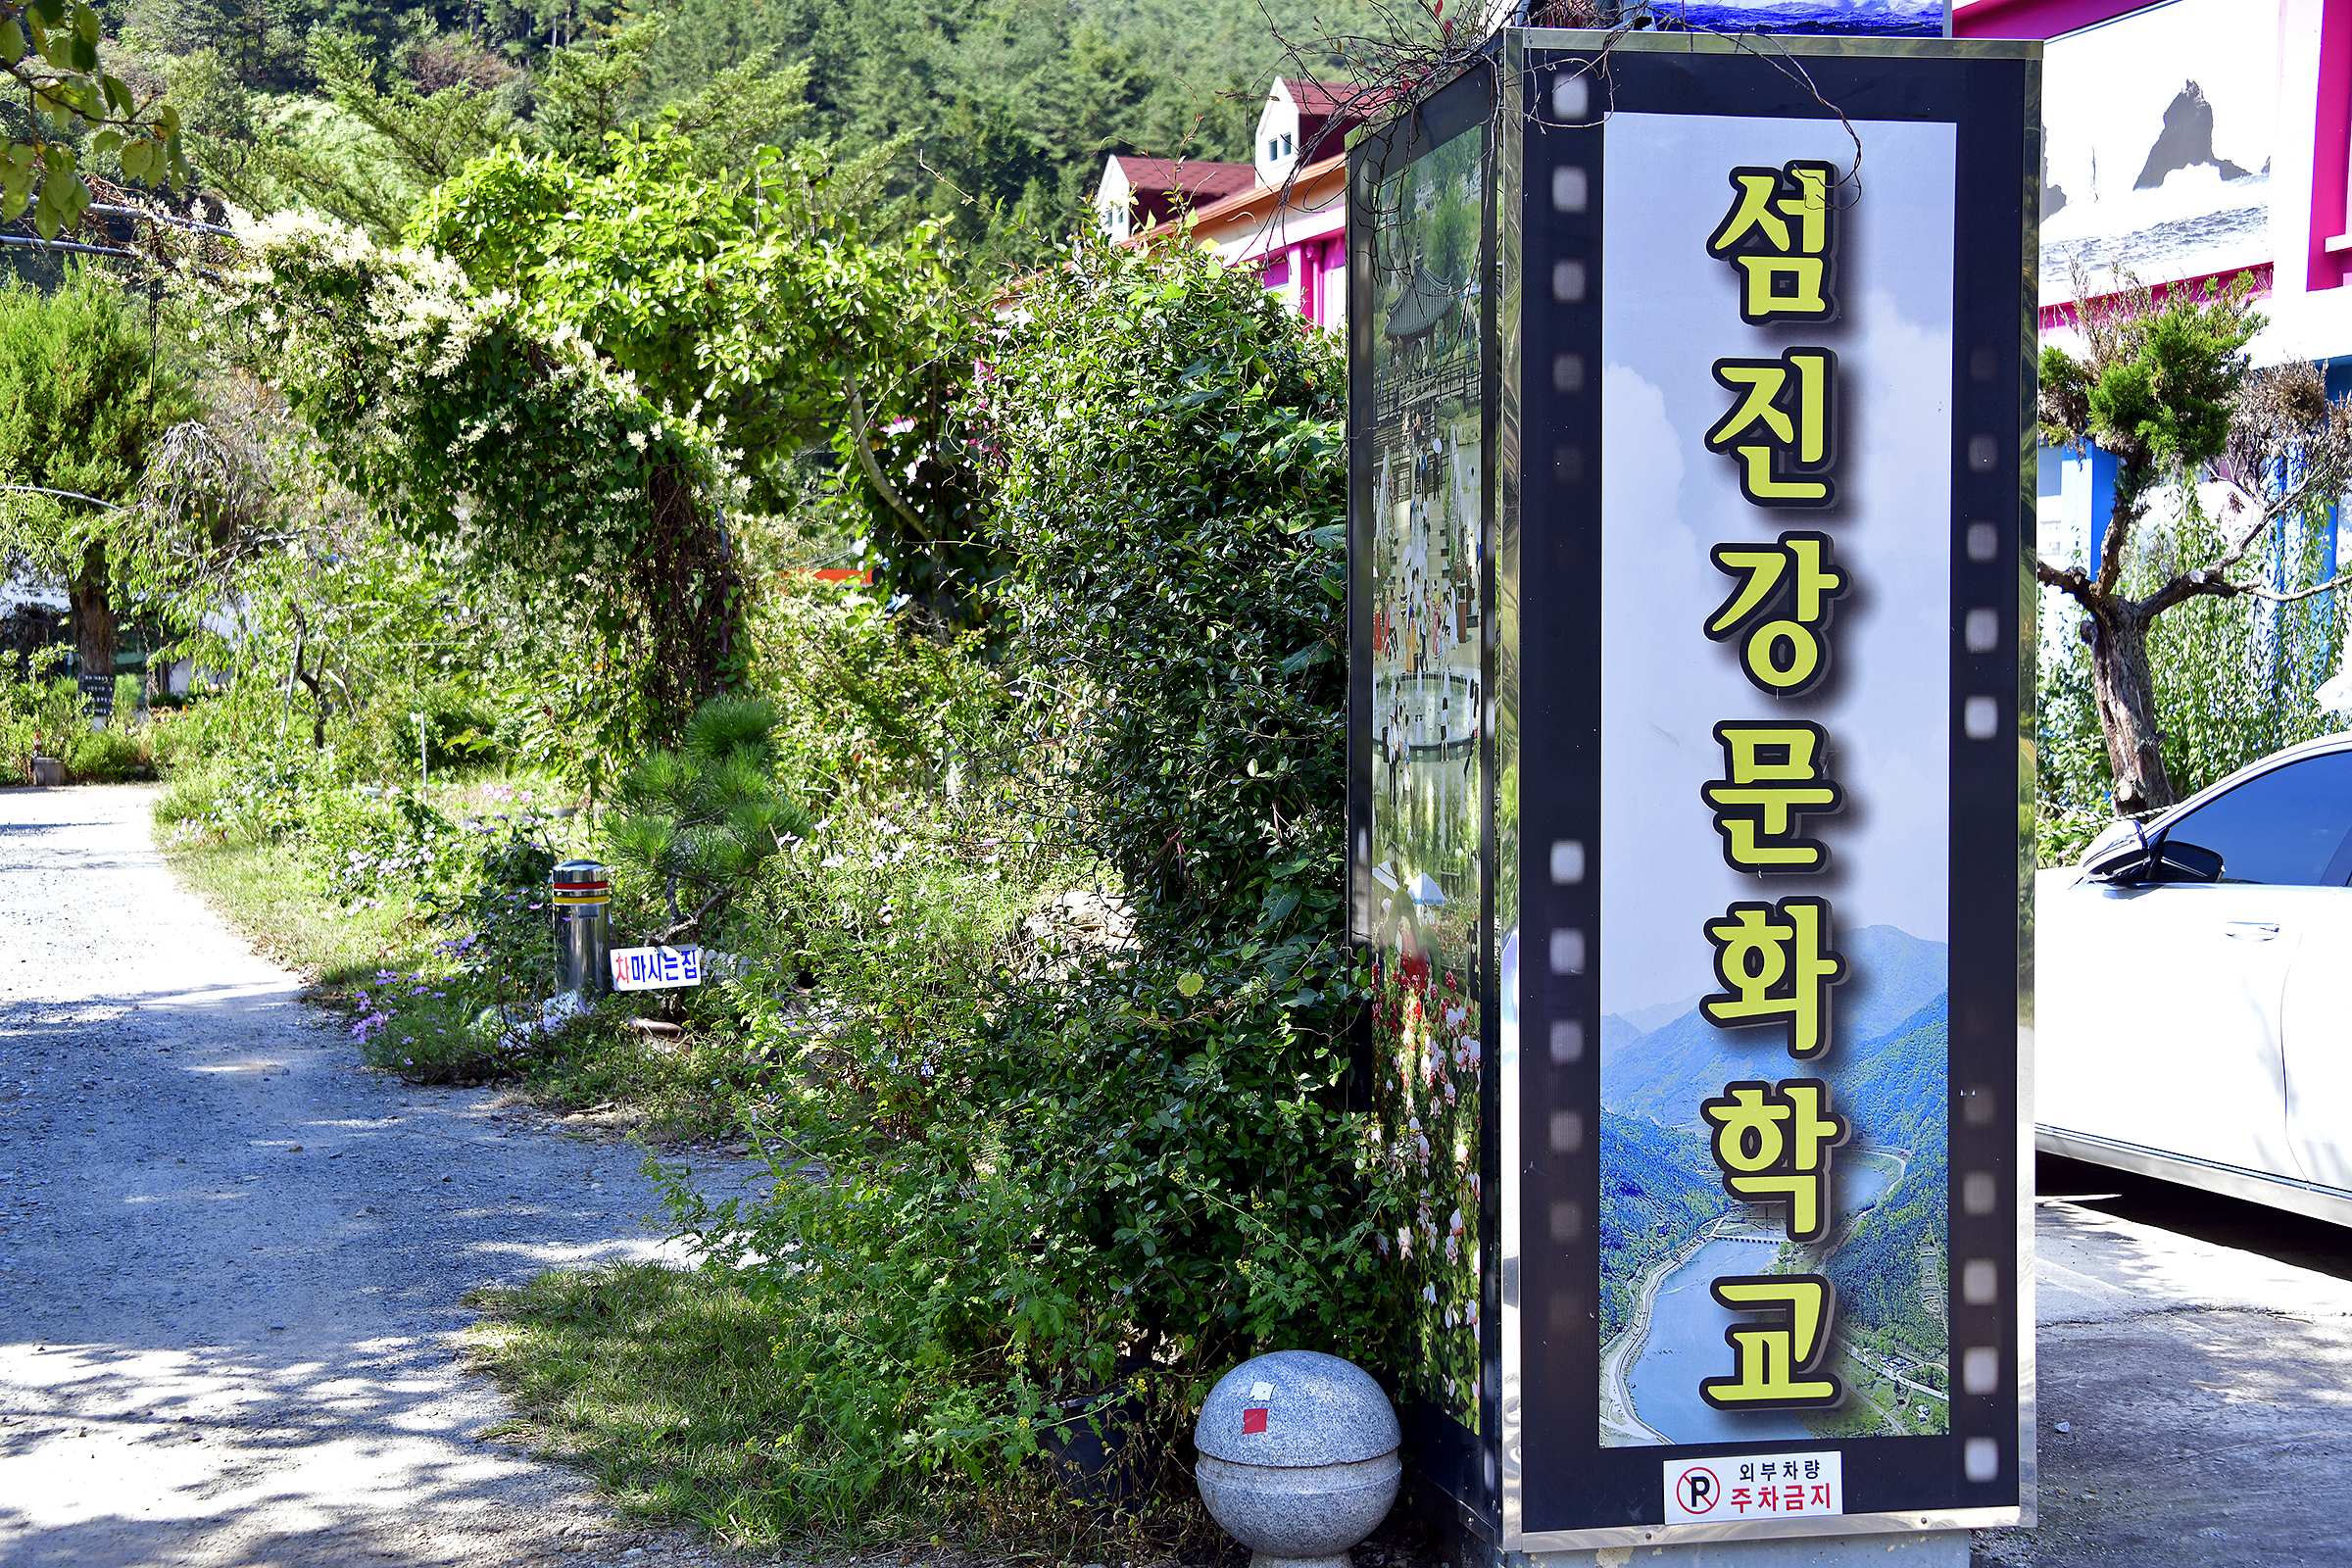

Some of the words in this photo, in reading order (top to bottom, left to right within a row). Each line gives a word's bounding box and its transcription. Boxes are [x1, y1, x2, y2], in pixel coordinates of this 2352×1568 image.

[614, 950, 698, 984] 차마시는집
[1739, 1459, 1820, 1482] 외부차량
[1730, 1482, 1831, 1514] 주차금지
